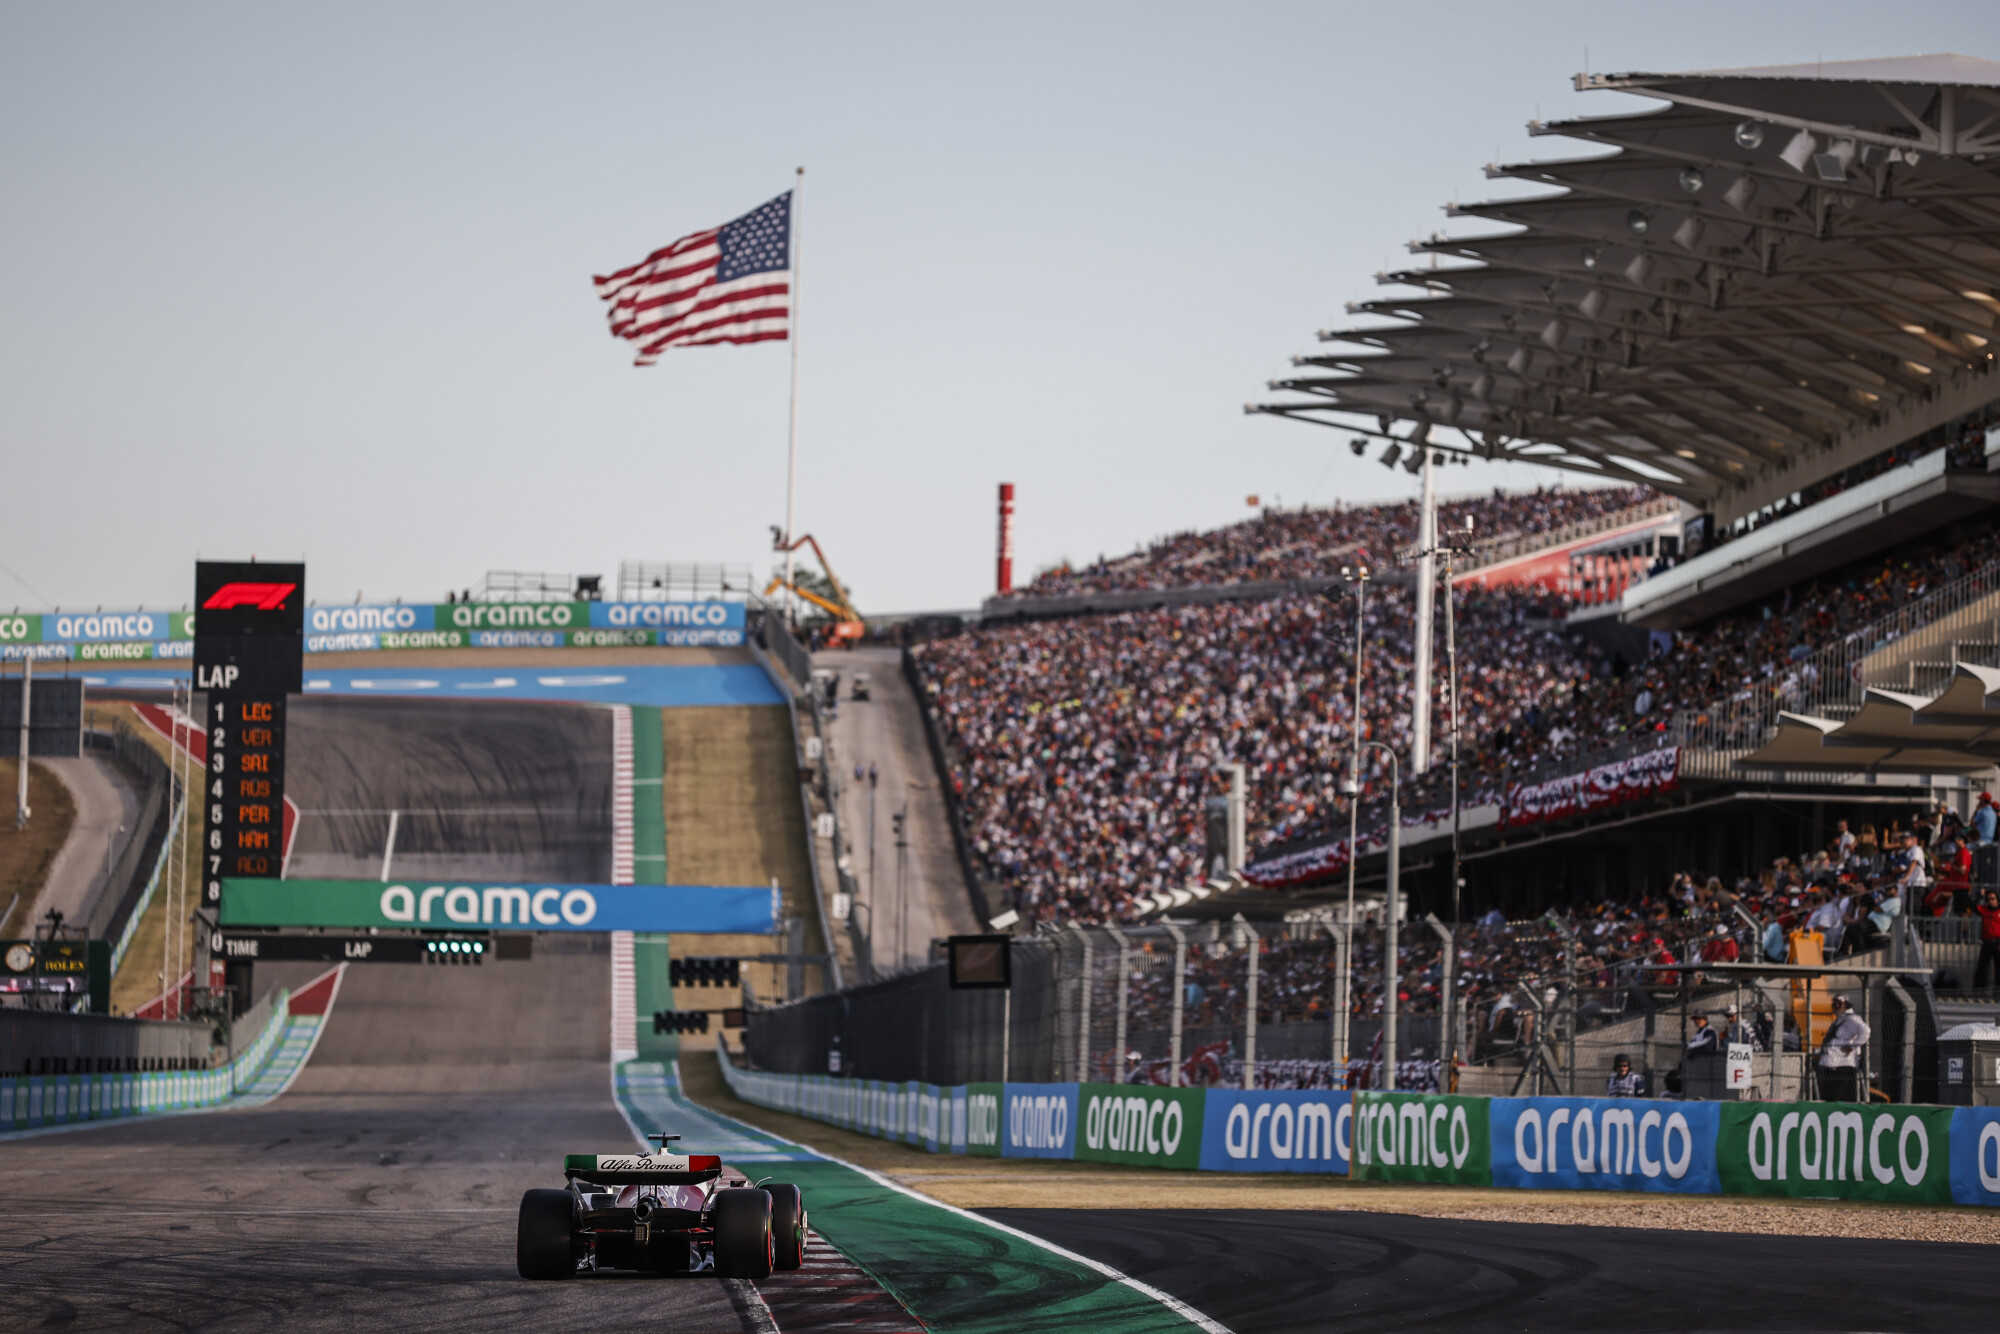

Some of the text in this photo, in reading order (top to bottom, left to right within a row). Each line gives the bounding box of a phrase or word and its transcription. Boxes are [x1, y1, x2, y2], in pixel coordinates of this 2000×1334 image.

[312, 607, 416, 631] aramco
[453, 605, 572, 627] aramco
[608, 604, 727, 626] aramco
[57, 615, 153, 638] aramco
[308, 633, 374, 651] aramco
[387, 631, 462, 648] aramco
[480, 630, 555, 647] aramco
[573, 629, 648, 646] aramco
[666, 629, 742, 646] aramco
[82, 642, 145, 659] aramco
[198, 664, 240, 689] LAP
[215, 702, 273, 722] 1 LEC
[213, 728, 272, 748] 2 VER
[213, 752, 270, 773] 3 SAI
[211, 778, 270, 799] 4 RUS
[211, 804, 270, 825] 5 PER
[210, 830, 269, 850] 6 HAM
[209, 855, 221, 875] 7
[208, 881, 220, 900] 8
[380, 886, 597, 926] aramco
[225, 939, 259, 957] TIME
[345, 941, 372, 958] LAP
[1729, 1050, 1751, 1061] 20A
[1733, 1069, 1745, 1084] F
[1010, 1095, 1067, 1149] aramco
[1086, 1095, 1183, 1156] aramco
[1225, 1102, 1352, 1162] aramc
[1357, 1102, 1470, 1170] aramco
[1514, 1107, 1692, 1180] aramco
[1748, 1111, 1929, 1187] aramco
[600, 1158, 685, 1173] Alfa Romeo
